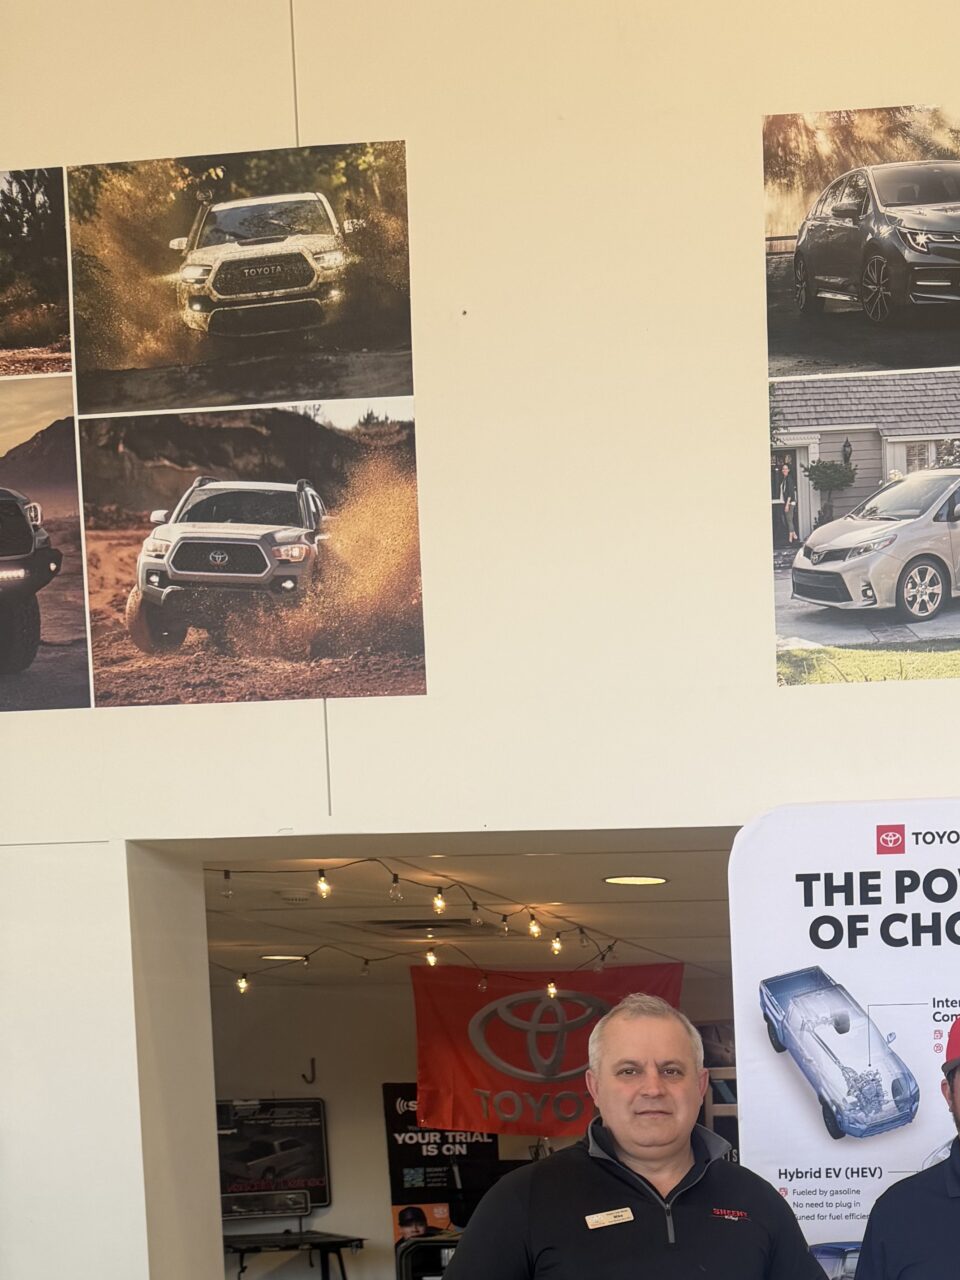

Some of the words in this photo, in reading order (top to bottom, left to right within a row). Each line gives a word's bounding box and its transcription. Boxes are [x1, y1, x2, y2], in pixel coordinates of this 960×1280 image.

[244, 265, 281, 277] TOYOTA
[795, 871, 882, 907] THE
[809, 914, 869, 949] OF
[393, 1132, 441, 1145] YOUR
[445, 1131, 493, 1143] TRIAL
[422, 1145, 440, 1156] IS
[442, 1144, 467, 1156] ON
[778, 1168, 821, 1182] Hybrid
[826, 1168, 842, 1179] EV
[845, 1166, 883, 1180] (HEV)
[792, 1188, 817, 1196] Fueled
[819, 1188, 828, 1198] by
[829, 1188, 861, 1198] gasoline
[793, 1201, 804, 1209] No
[805, 1201, 824, 1209] need
[835, 1200, 852, 1210] plug
[854, 1200, 861, 1208] in
[795, 1213, 816, 1221] uned
[817, 1213, 828, 1221] for
